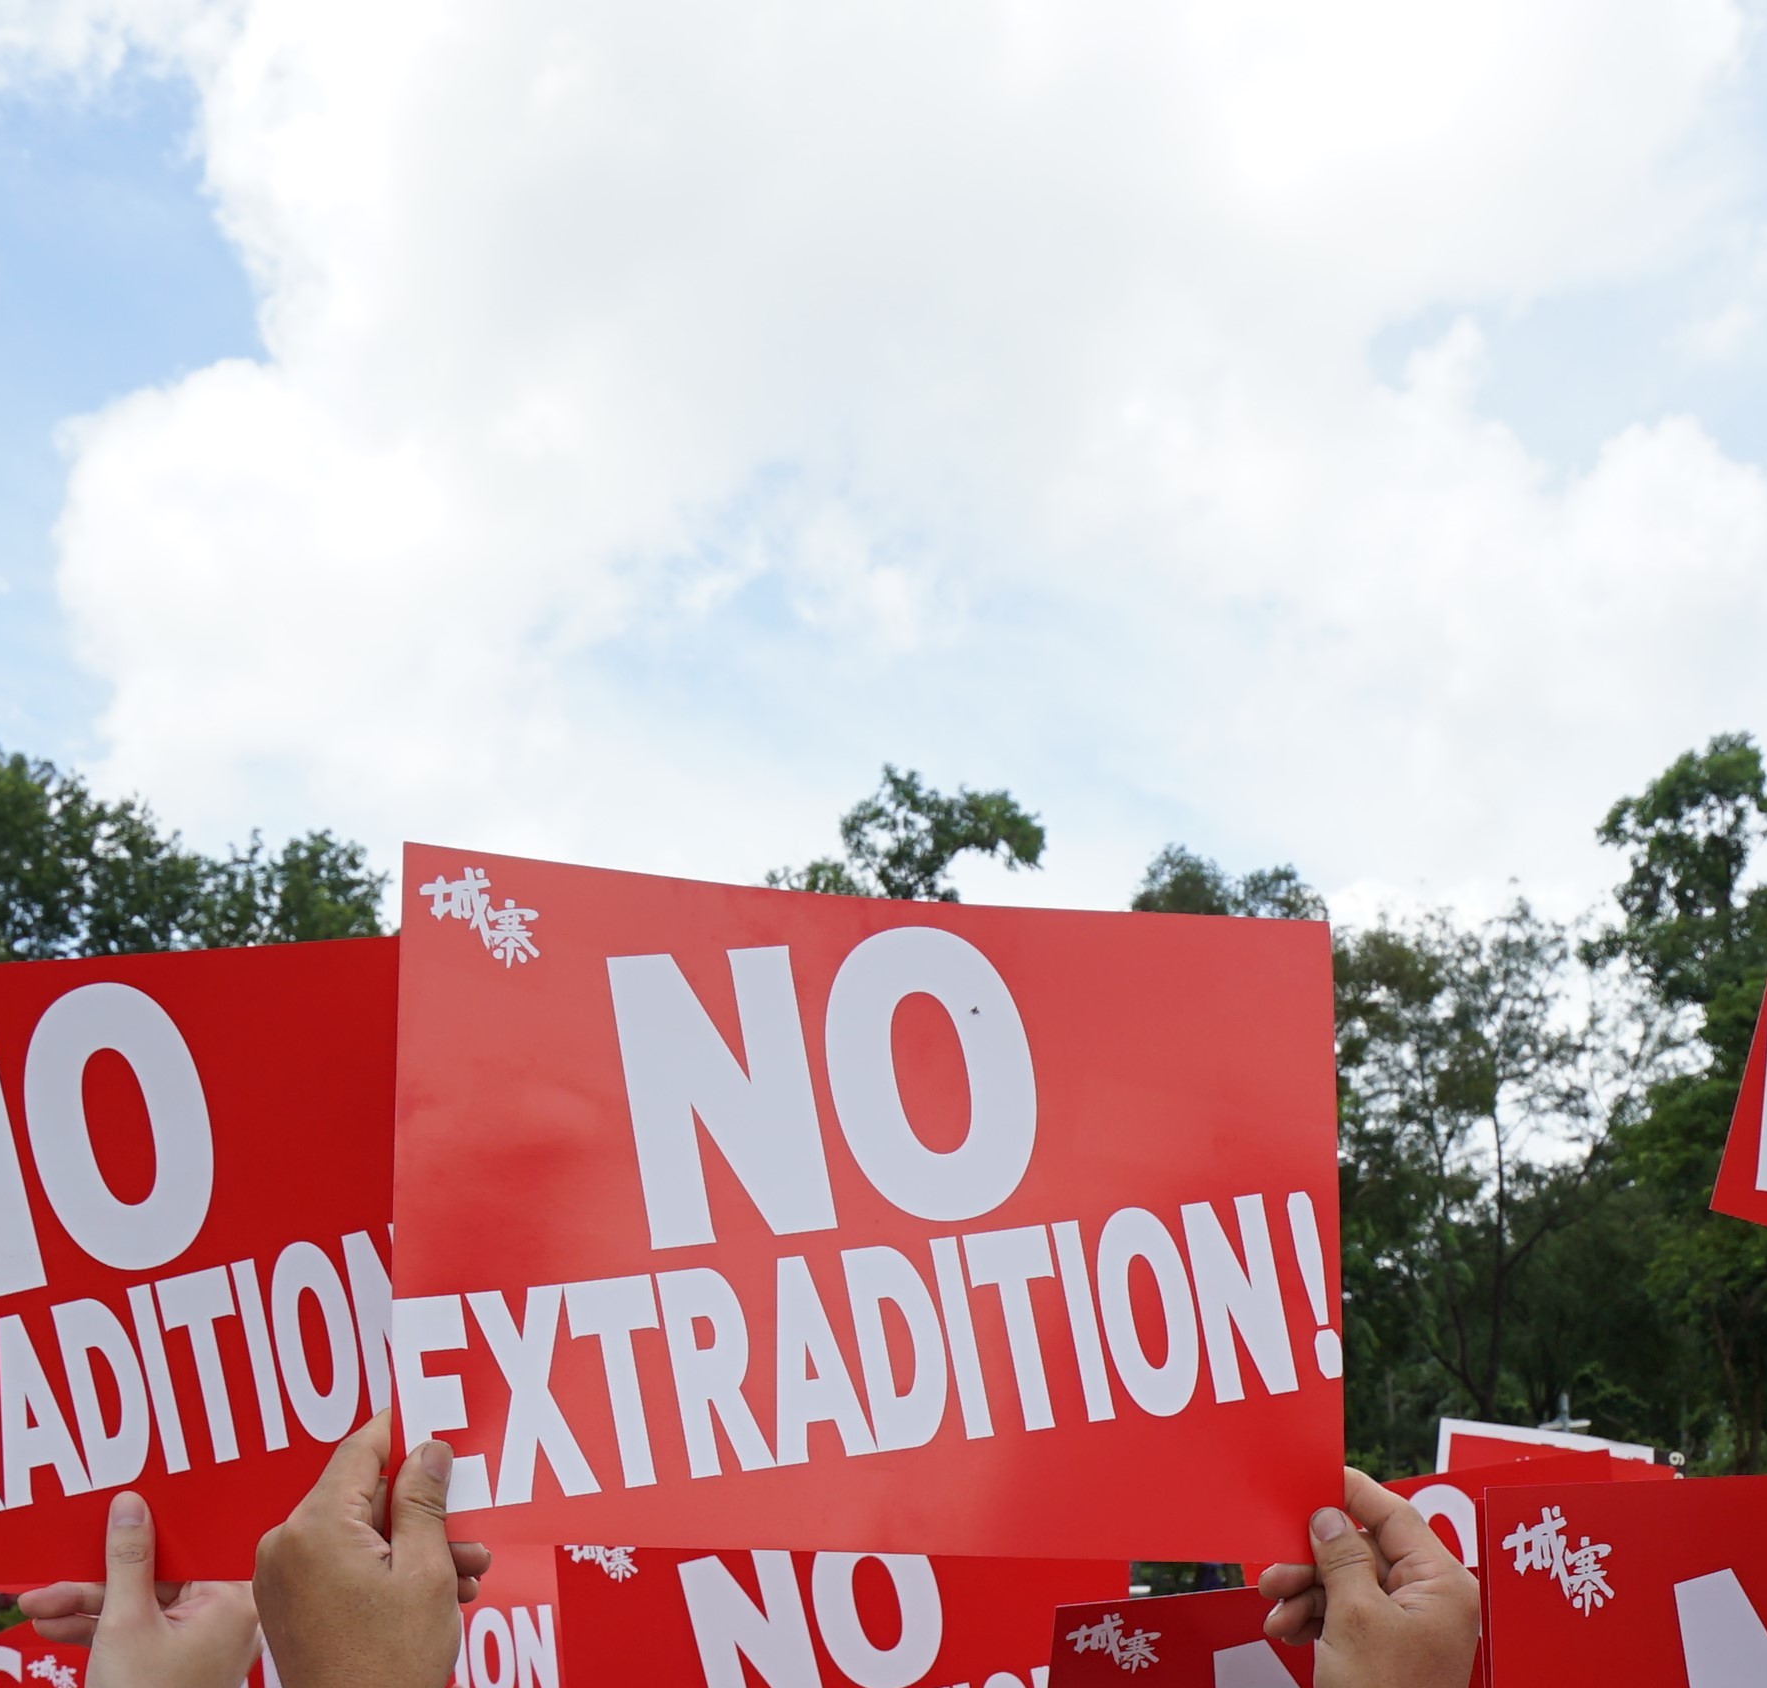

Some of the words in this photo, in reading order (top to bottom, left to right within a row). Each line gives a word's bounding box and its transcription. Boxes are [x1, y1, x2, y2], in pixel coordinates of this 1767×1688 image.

[419, 867, 540, 968] 城寨
[606, 926, 1038, 1250] NO
[392, 1191, 1343, 1514] EXTRADITION!
[1503, 1505, 1615, 1617] 城寨
